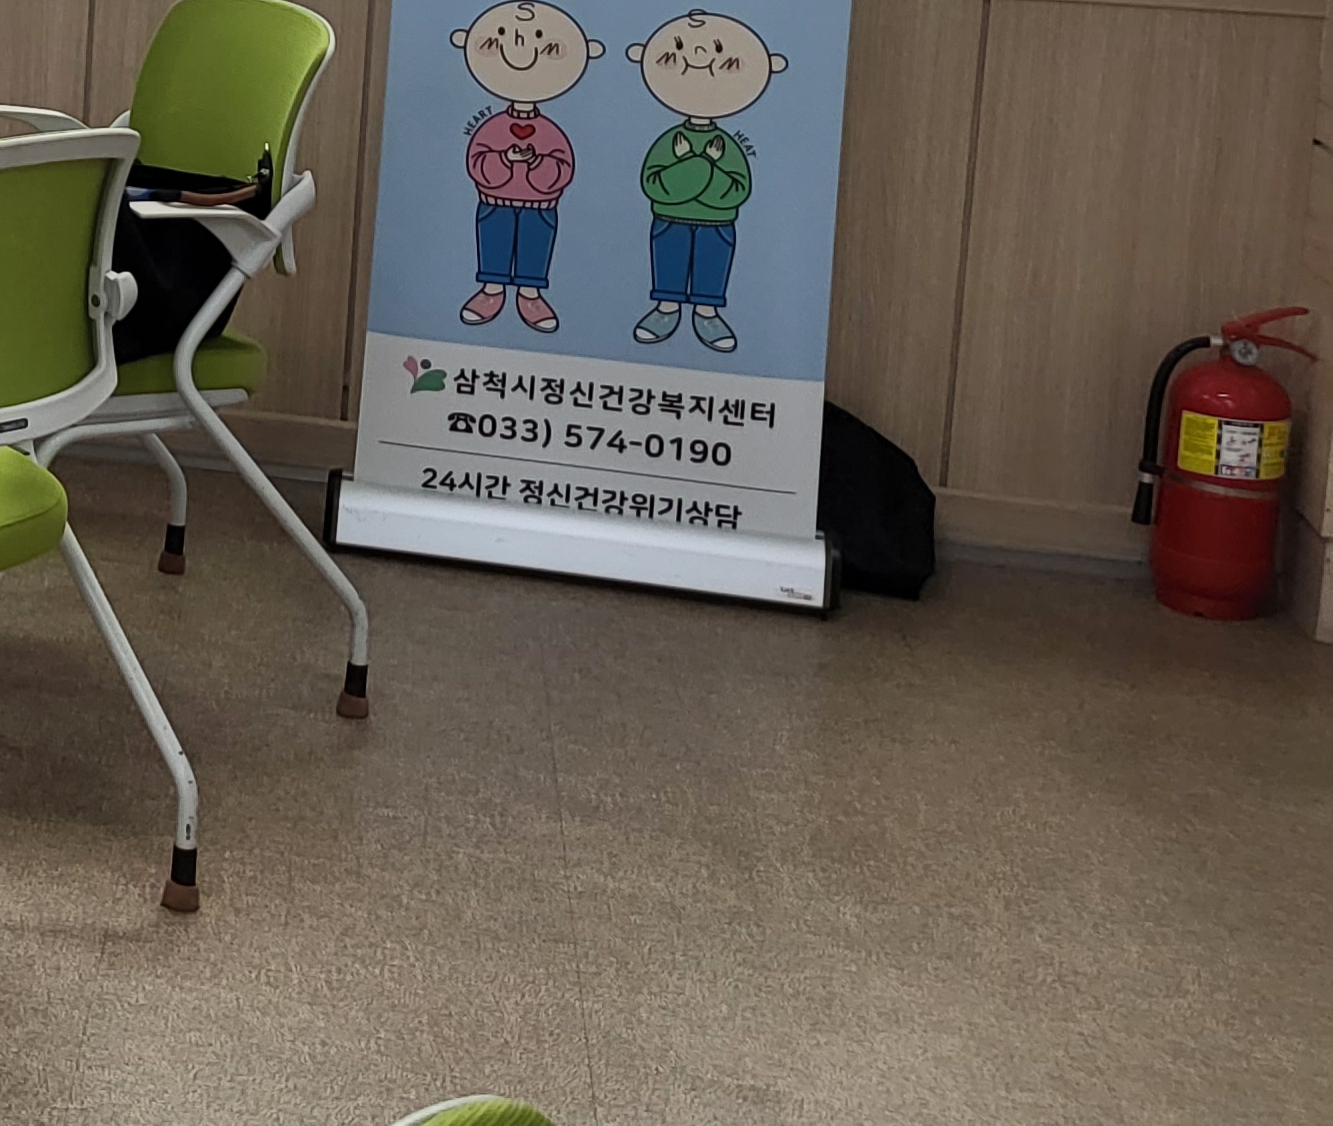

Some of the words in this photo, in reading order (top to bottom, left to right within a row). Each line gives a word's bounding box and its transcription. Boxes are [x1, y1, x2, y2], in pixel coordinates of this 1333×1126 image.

[463, 105, 493, 136] HEART
[733, 130, 757, 158] HEAT
[453, 368, 776, 429] 삼척시정신건강복지센터
[564, 424, 732, 467] 574-0190
[421, 468, 511, 500] 24시간
[519, 478, 743, 530] 정신건강위기상담
